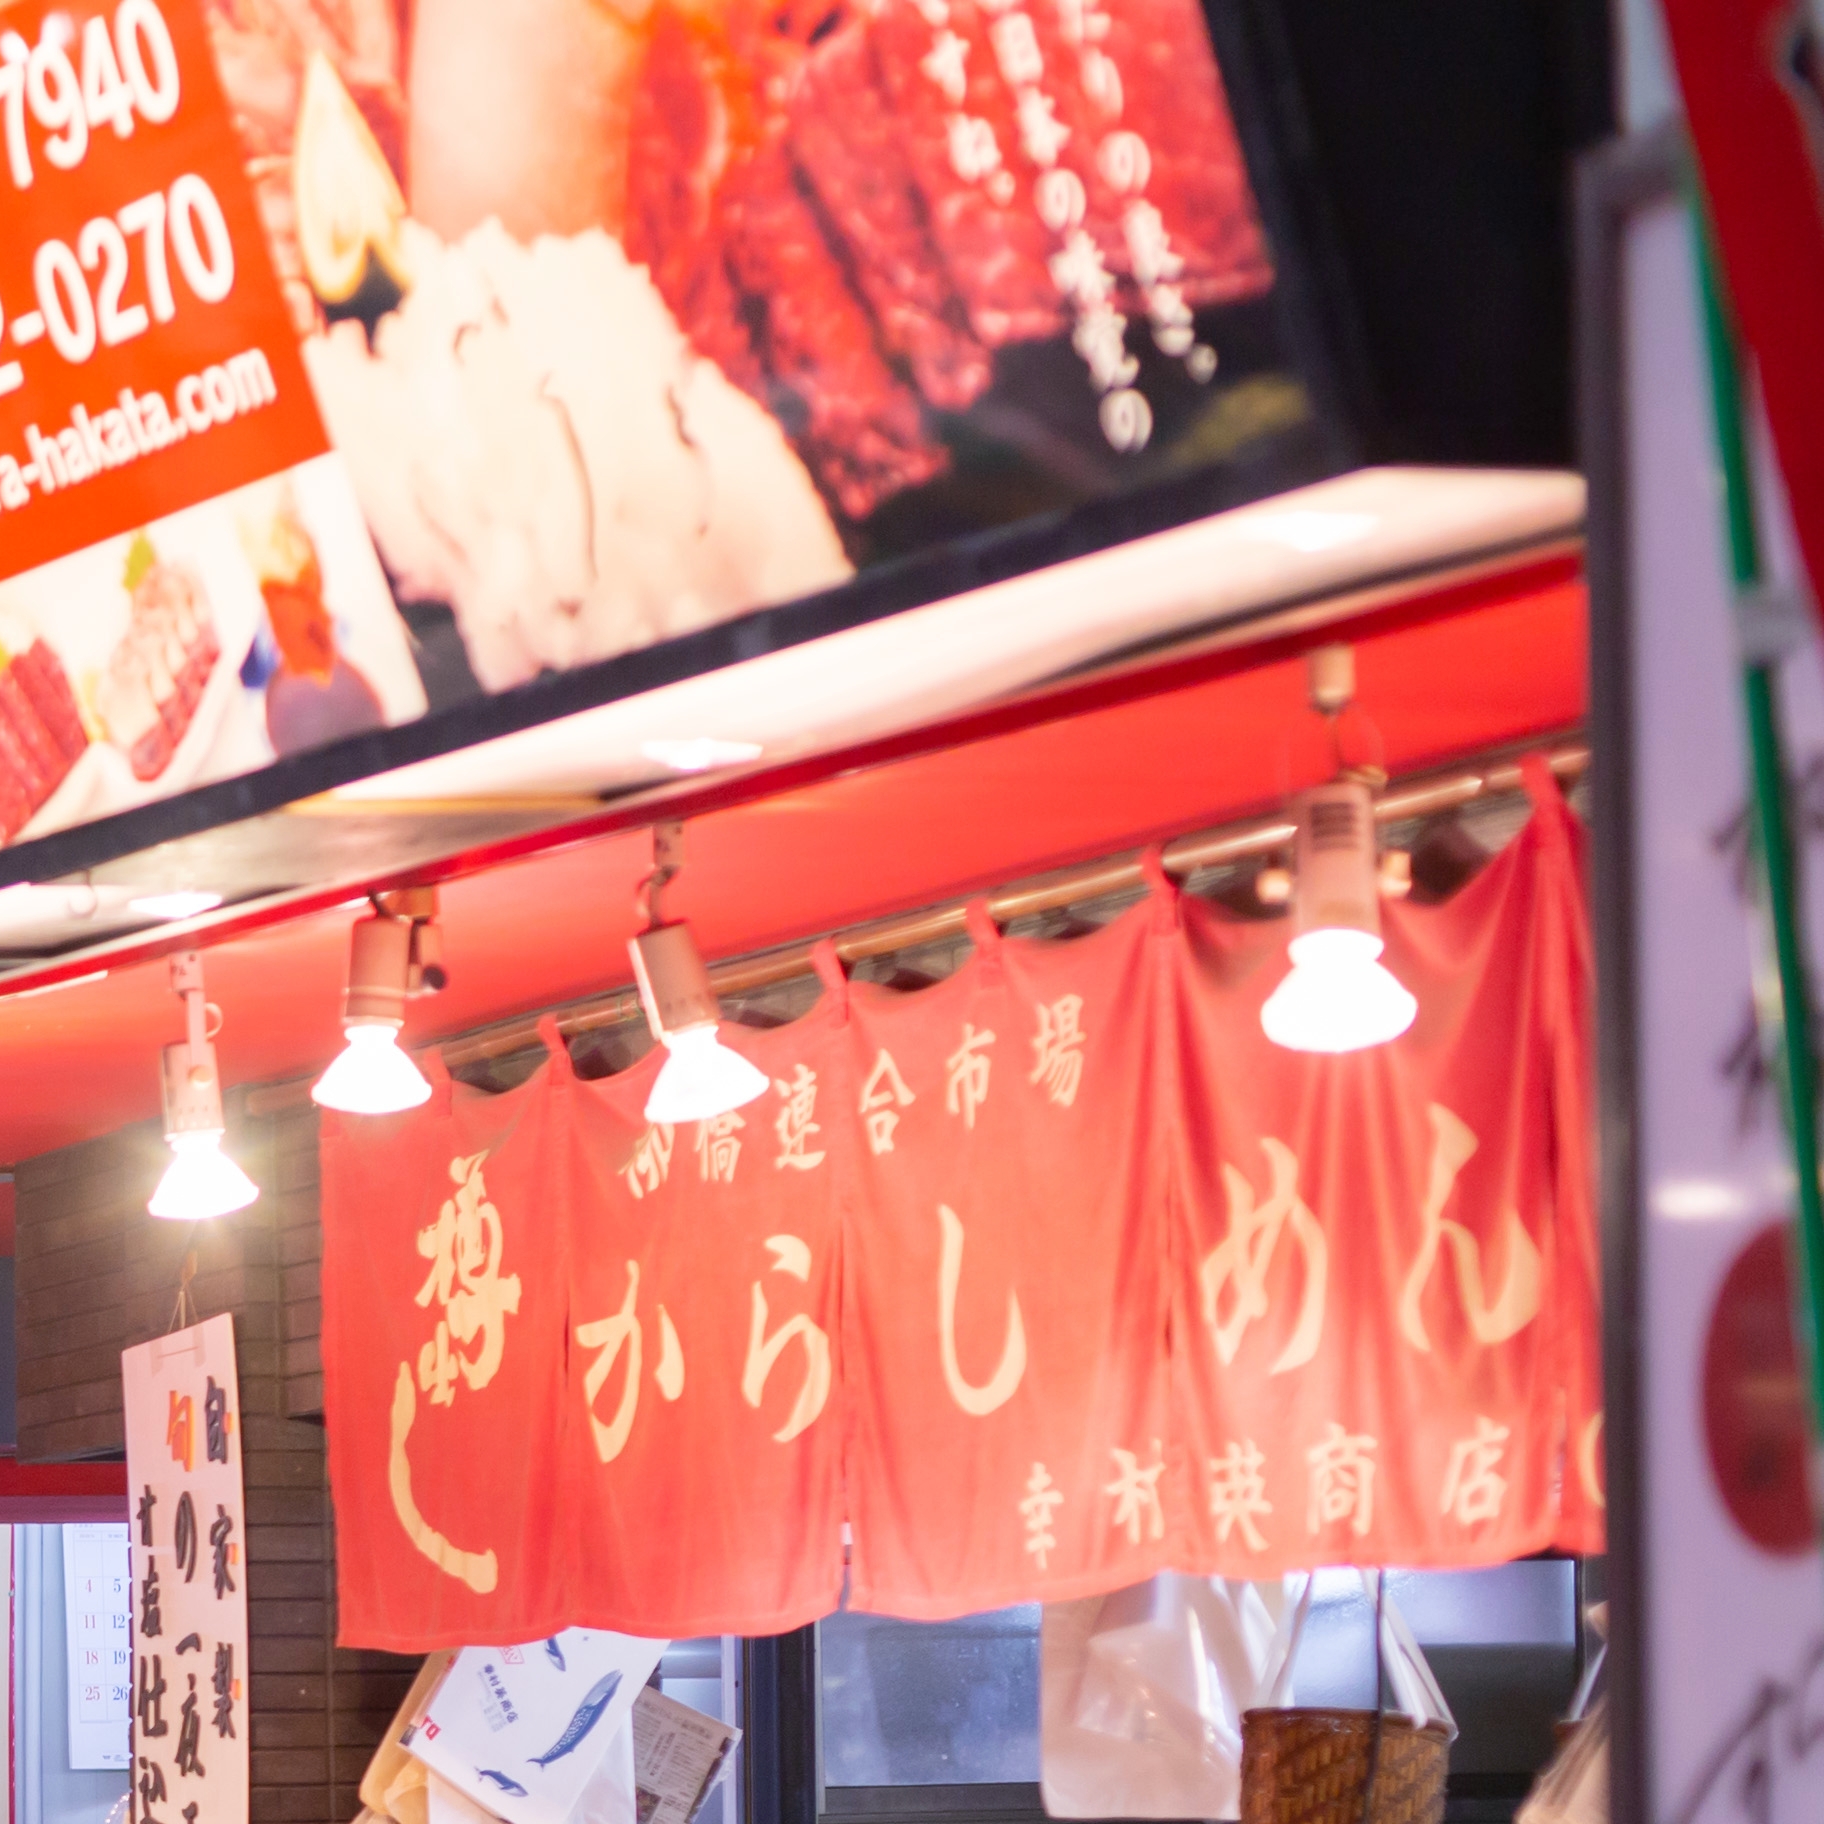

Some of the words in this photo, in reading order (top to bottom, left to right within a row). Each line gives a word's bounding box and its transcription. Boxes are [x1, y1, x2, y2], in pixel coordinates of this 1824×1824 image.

[112, 1578, 122, 1594] 5
[83, 1614, 97, 1630] 11
[111, 1614, 126, 1630] 12
[84, 1649, 99, 1666] 18
[112, 1649, 127, 1666] 19
[84, 1685, 101, 1702] 25
[111, 1685, 129, 1702] 26
